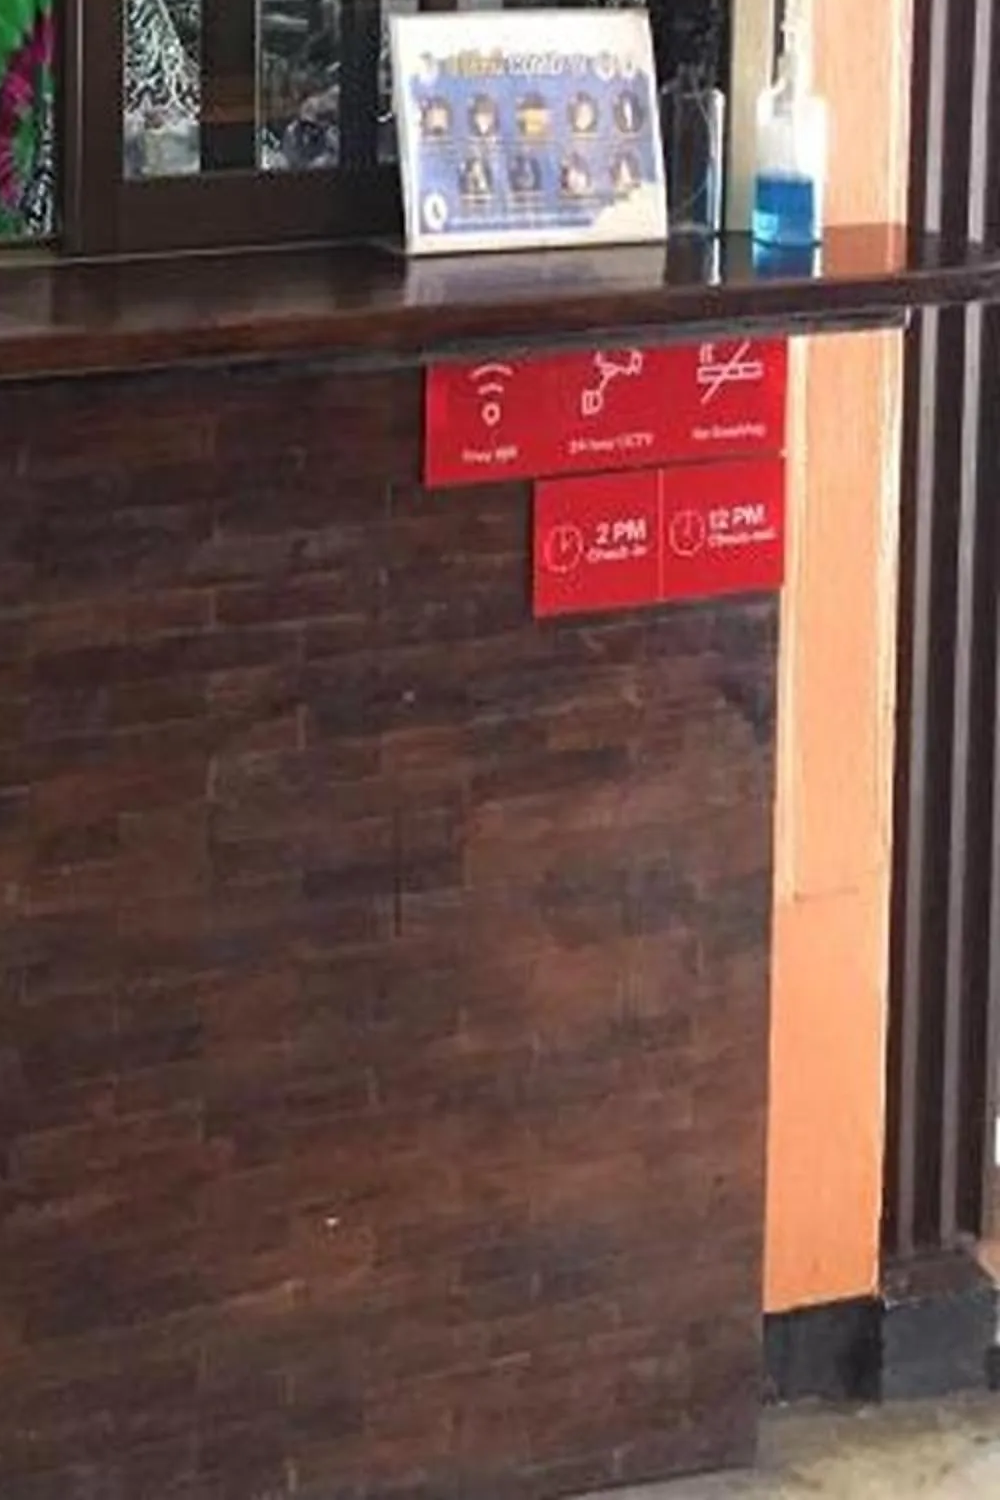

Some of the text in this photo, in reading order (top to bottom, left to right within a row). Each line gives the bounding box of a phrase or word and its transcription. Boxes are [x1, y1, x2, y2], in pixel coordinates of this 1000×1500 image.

[709, 504, 766, 530] 12 PM
[596, 518, 647, 544] 2 PM
